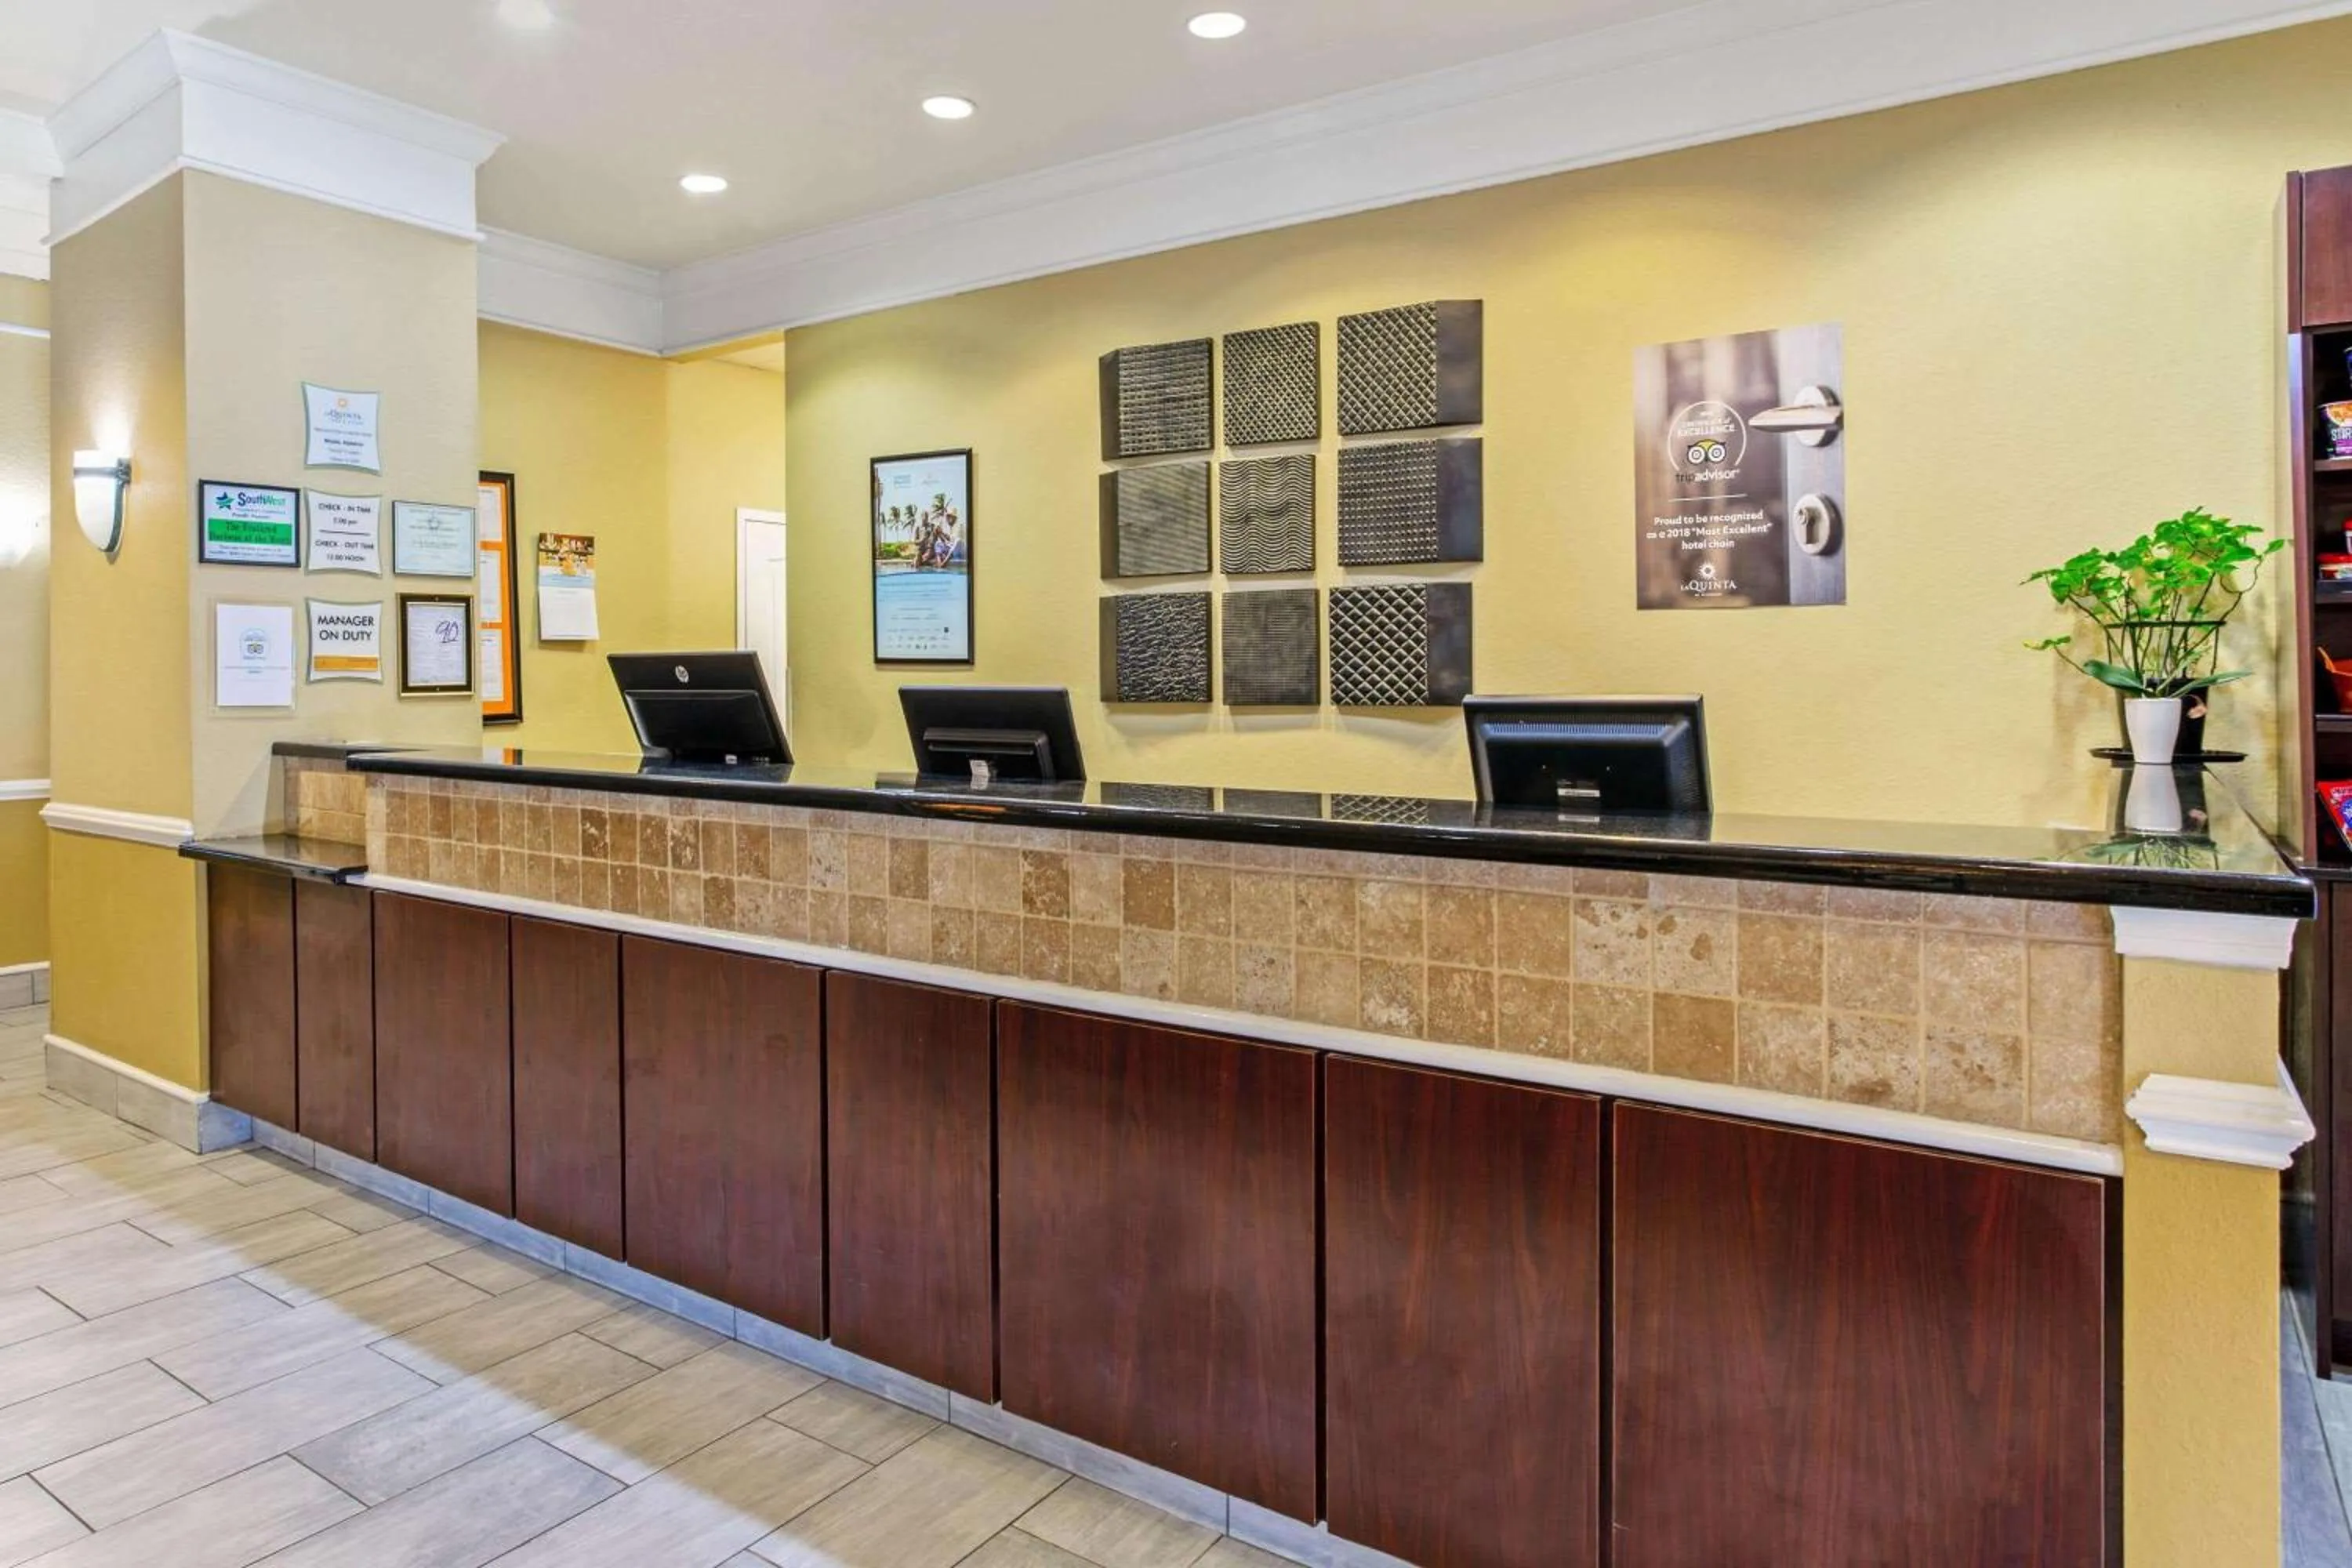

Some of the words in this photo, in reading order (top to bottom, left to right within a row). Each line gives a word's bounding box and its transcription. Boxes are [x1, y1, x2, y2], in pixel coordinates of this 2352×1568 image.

[318, 503, 341, 512] CHECK
[1653, 515, 1682, 525] Proud
[1683, 516, 1694, 524] to
[1696, 514, 1708, 524] be
[1710, 509, 1763, 523] recognized
[1667, 528, 1691, 539] 2018
[1681, 539, 1707, 550] hotel
[1708, 538, 1735, 550] chain
[318, 615, 374, 626] MANAGER
[319, 630, 339, 641] ON
[343, 630, 372, 641] DUTY
